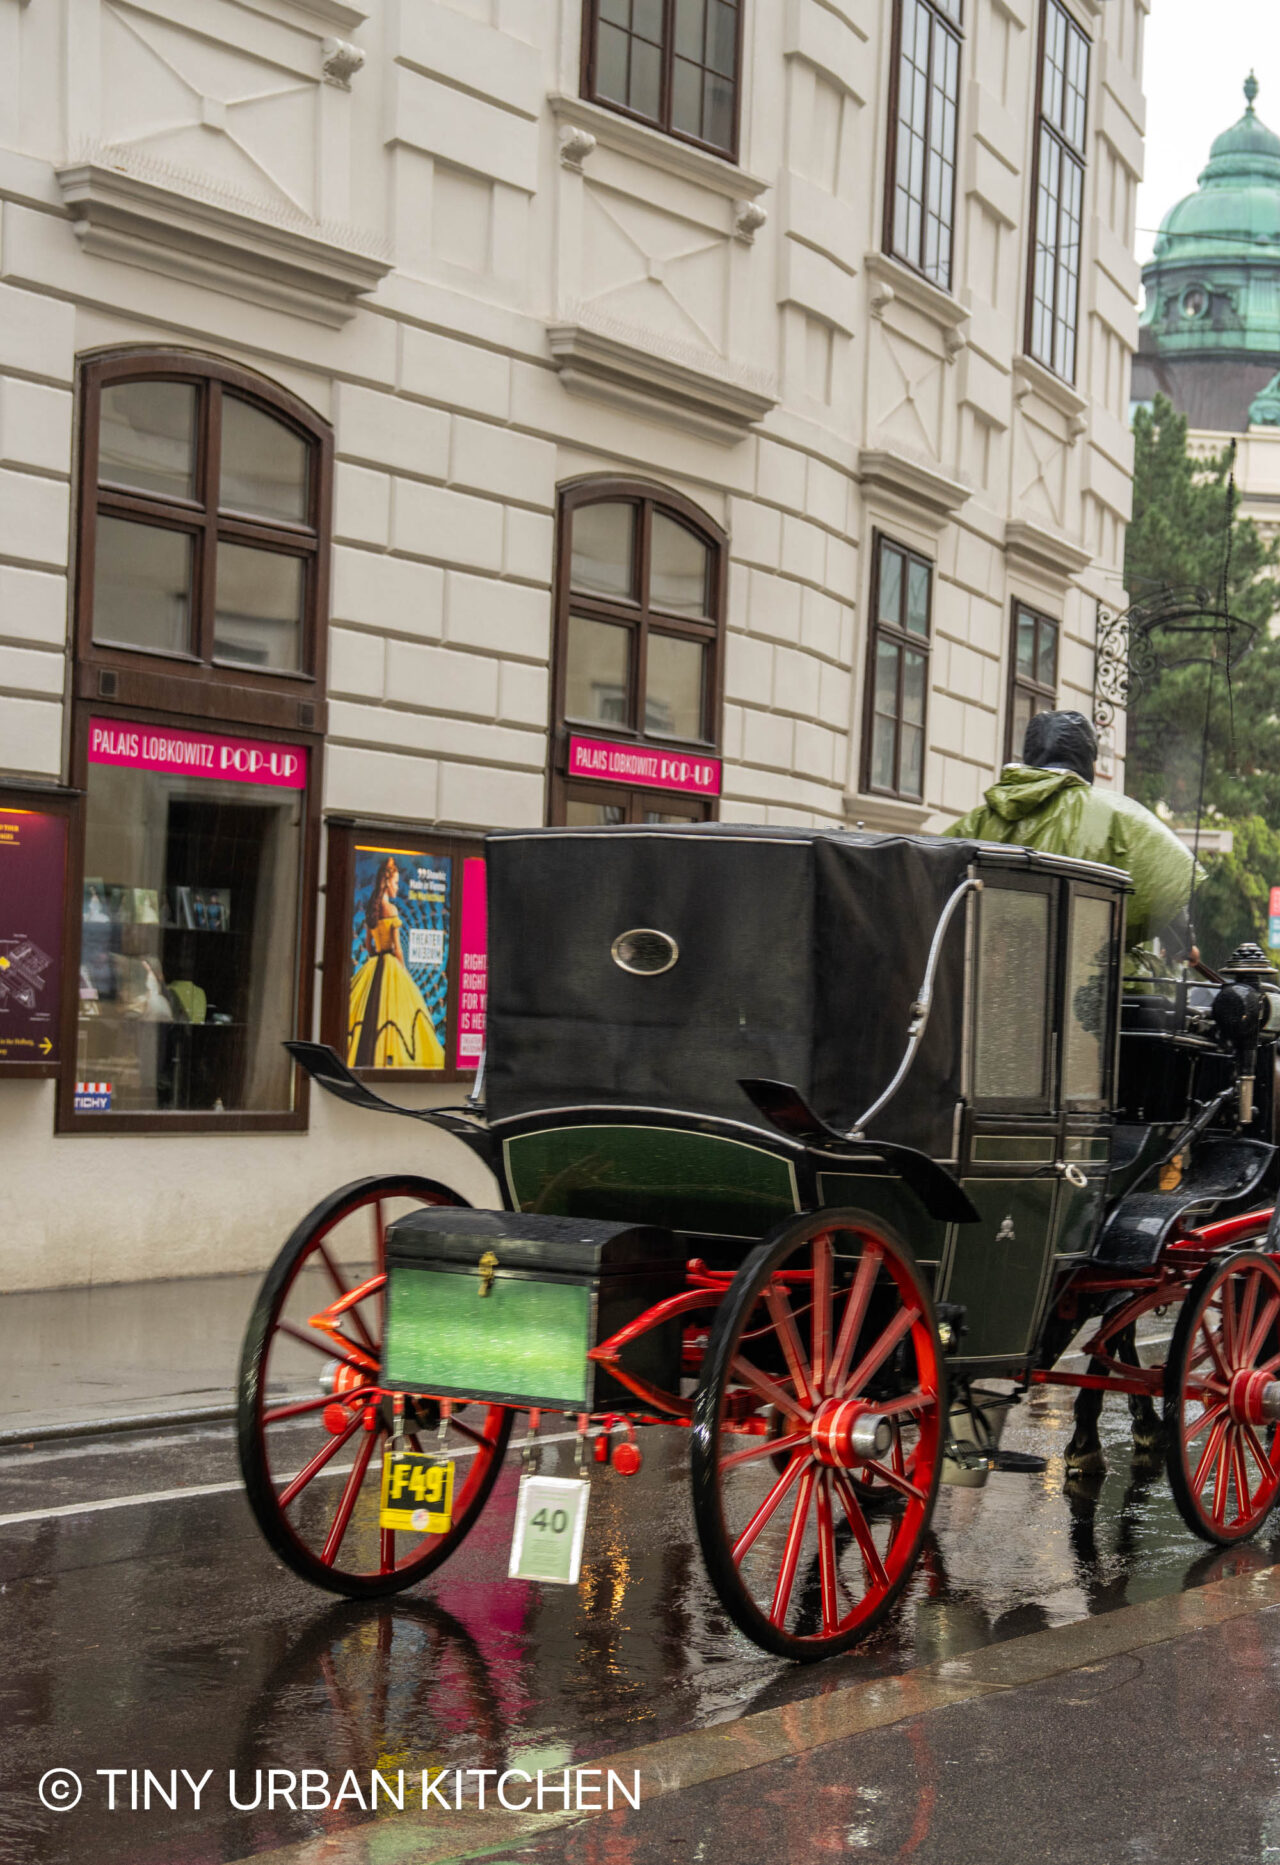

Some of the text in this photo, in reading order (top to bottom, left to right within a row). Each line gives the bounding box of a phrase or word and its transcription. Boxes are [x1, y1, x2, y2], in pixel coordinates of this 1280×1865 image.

[92, 728, 298, 777] PALAIS LOBKOWITZ POP-UP
[576, 746, 714, 786] PALAIS LOBKOWITZ POP-UP
[463, 953, 488, 970] RIGHT
[462, 973, 487, 990] RIGHT
[461, 993, 478, 1010] FOR
[461, 1013, 471, 1029] IS
[74, 1097, 108, 1108] TICHY
[390, 1463, 444, 1503] F49
[530, 1507, 569, 1534] 40
